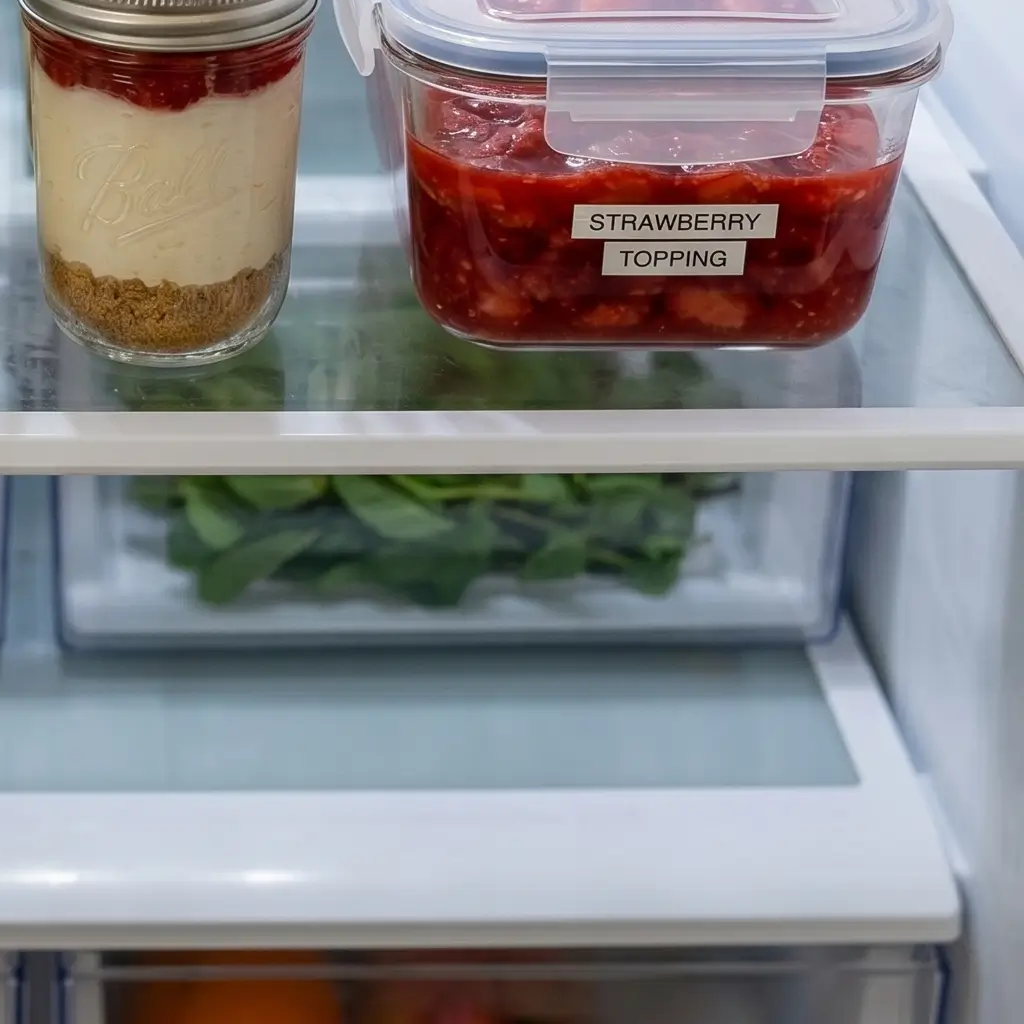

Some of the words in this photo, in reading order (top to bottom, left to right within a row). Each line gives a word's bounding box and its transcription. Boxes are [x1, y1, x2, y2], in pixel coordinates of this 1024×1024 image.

[73, 140, 237, 236] Ball
[589, 213, 762, 232] STRAWBERRY
[619, 250, 728, 268] TOPPING
